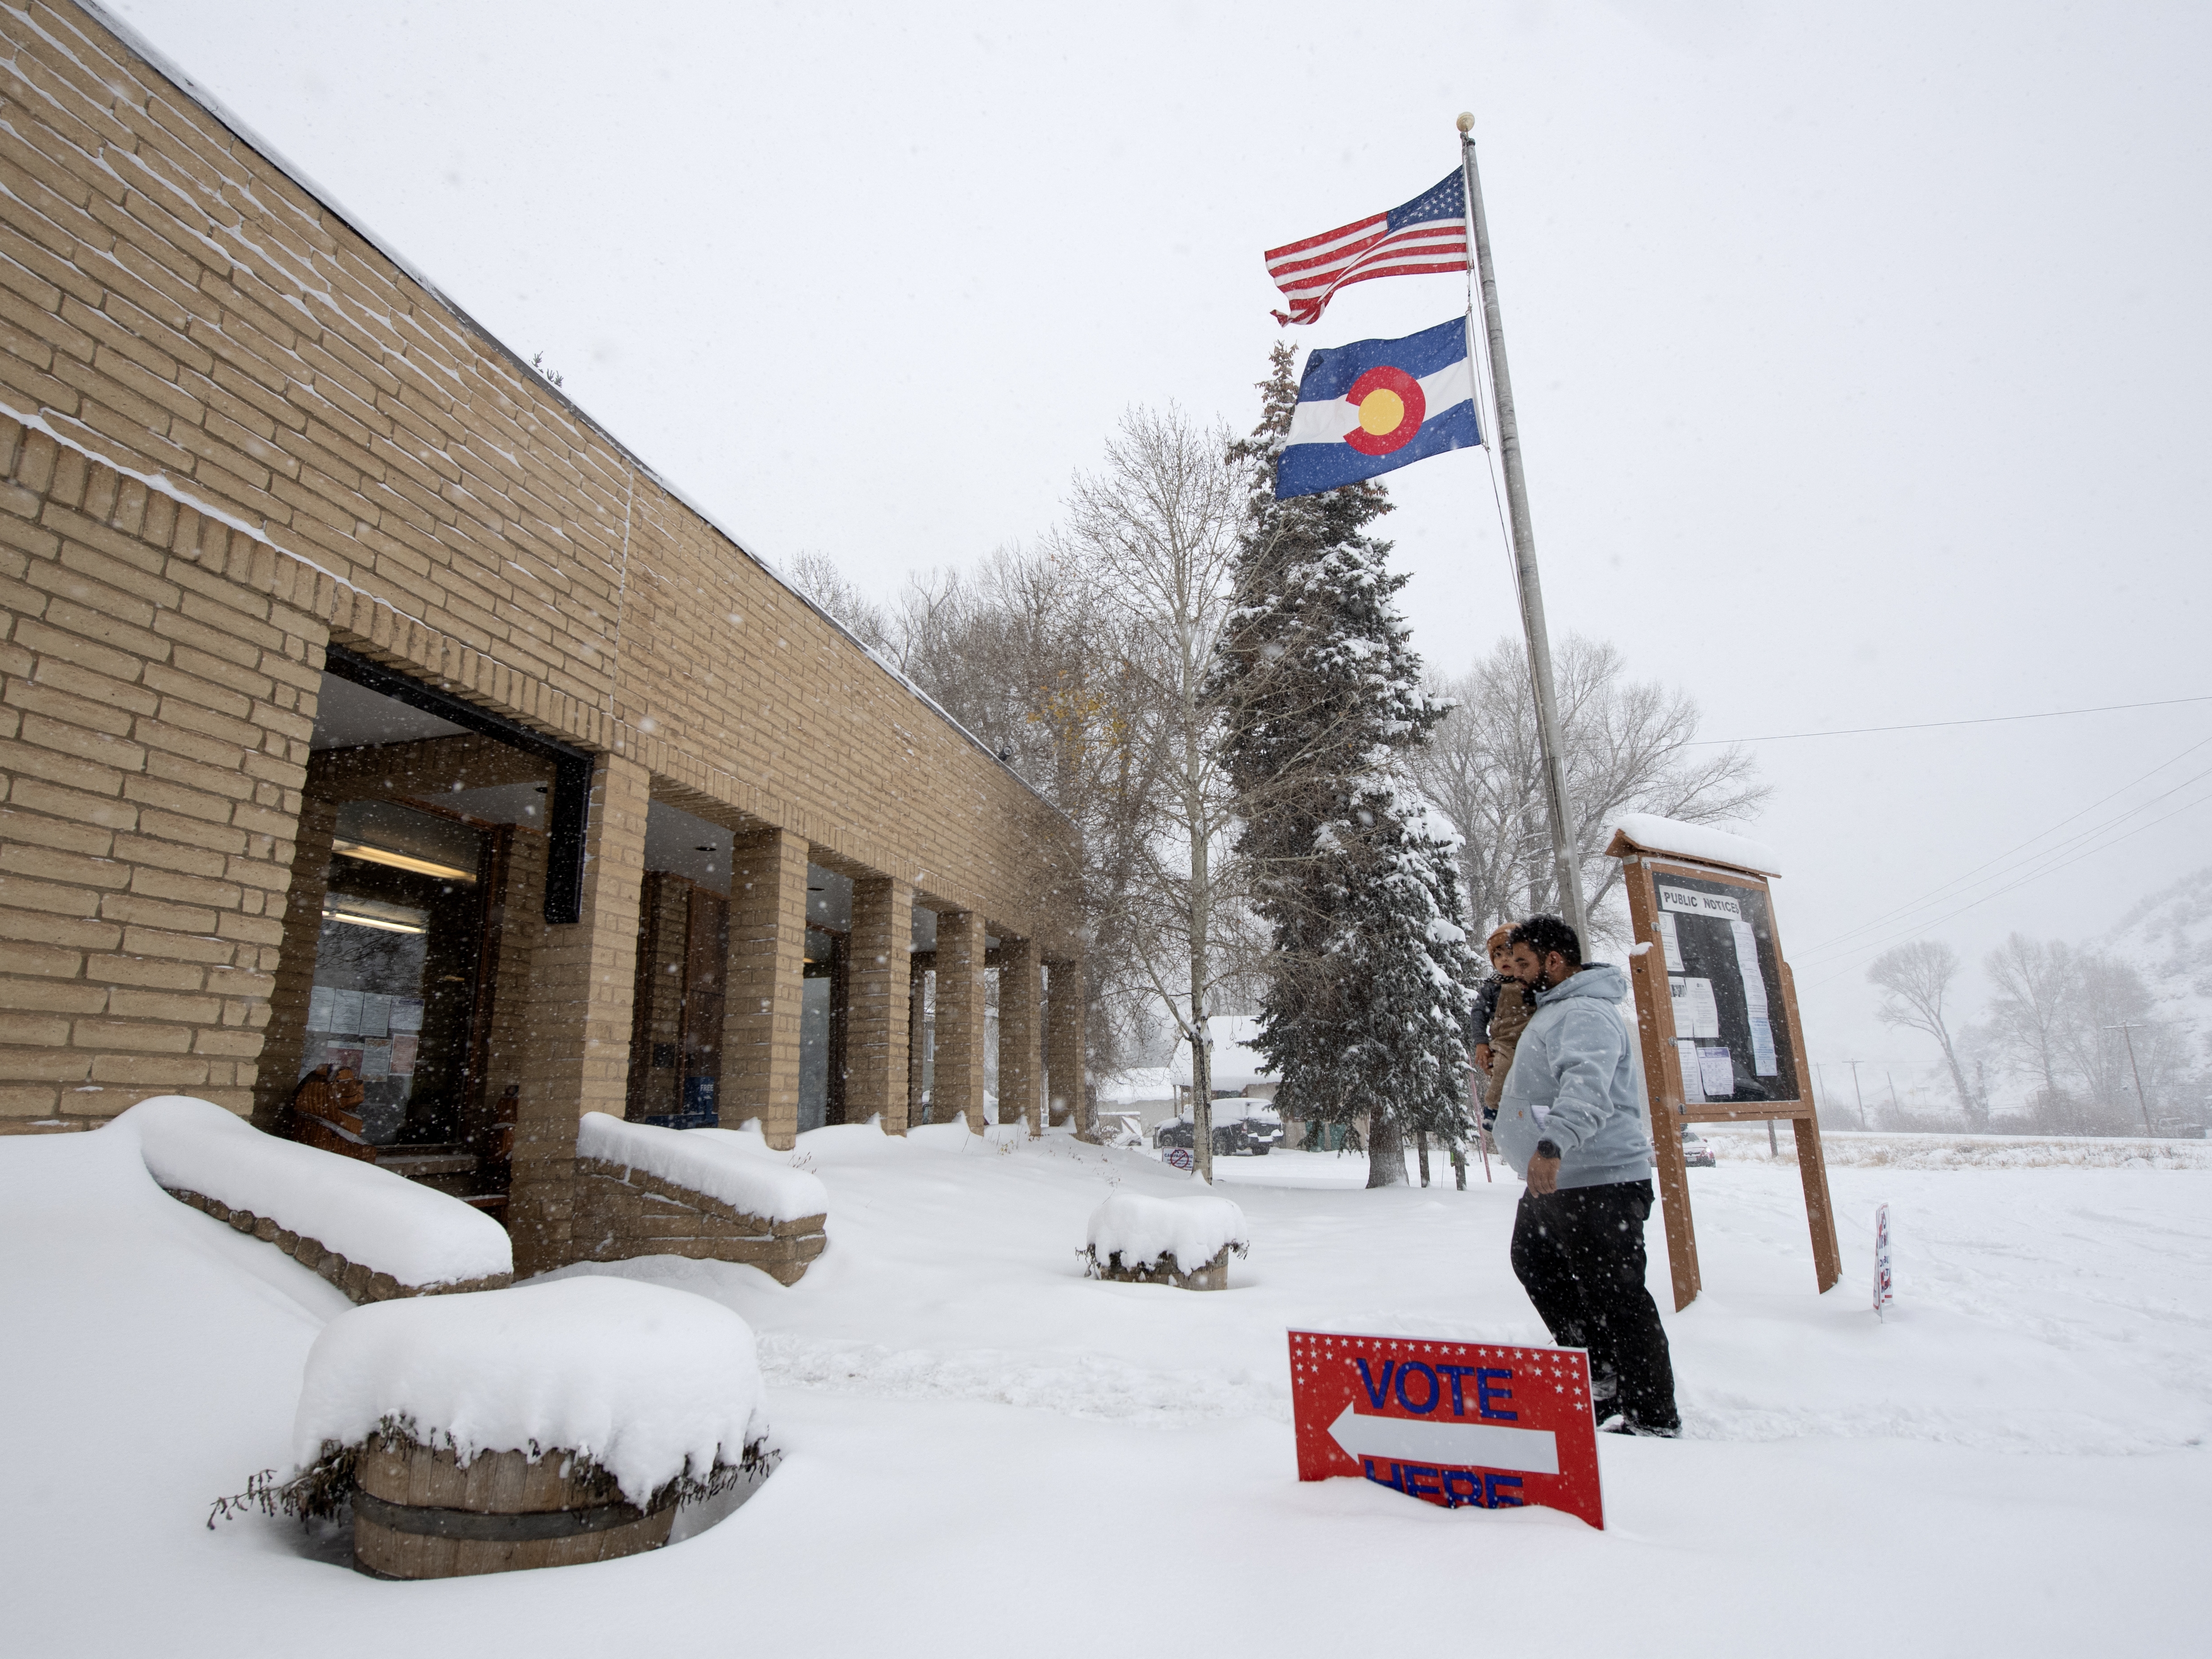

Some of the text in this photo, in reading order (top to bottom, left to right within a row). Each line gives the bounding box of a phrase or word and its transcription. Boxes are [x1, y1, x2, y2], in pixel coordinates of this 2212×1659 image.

[1664, 892, 1740, 914] PUBLIC NOTICES
[1356, 1358, 1518, 1421] VOTE
